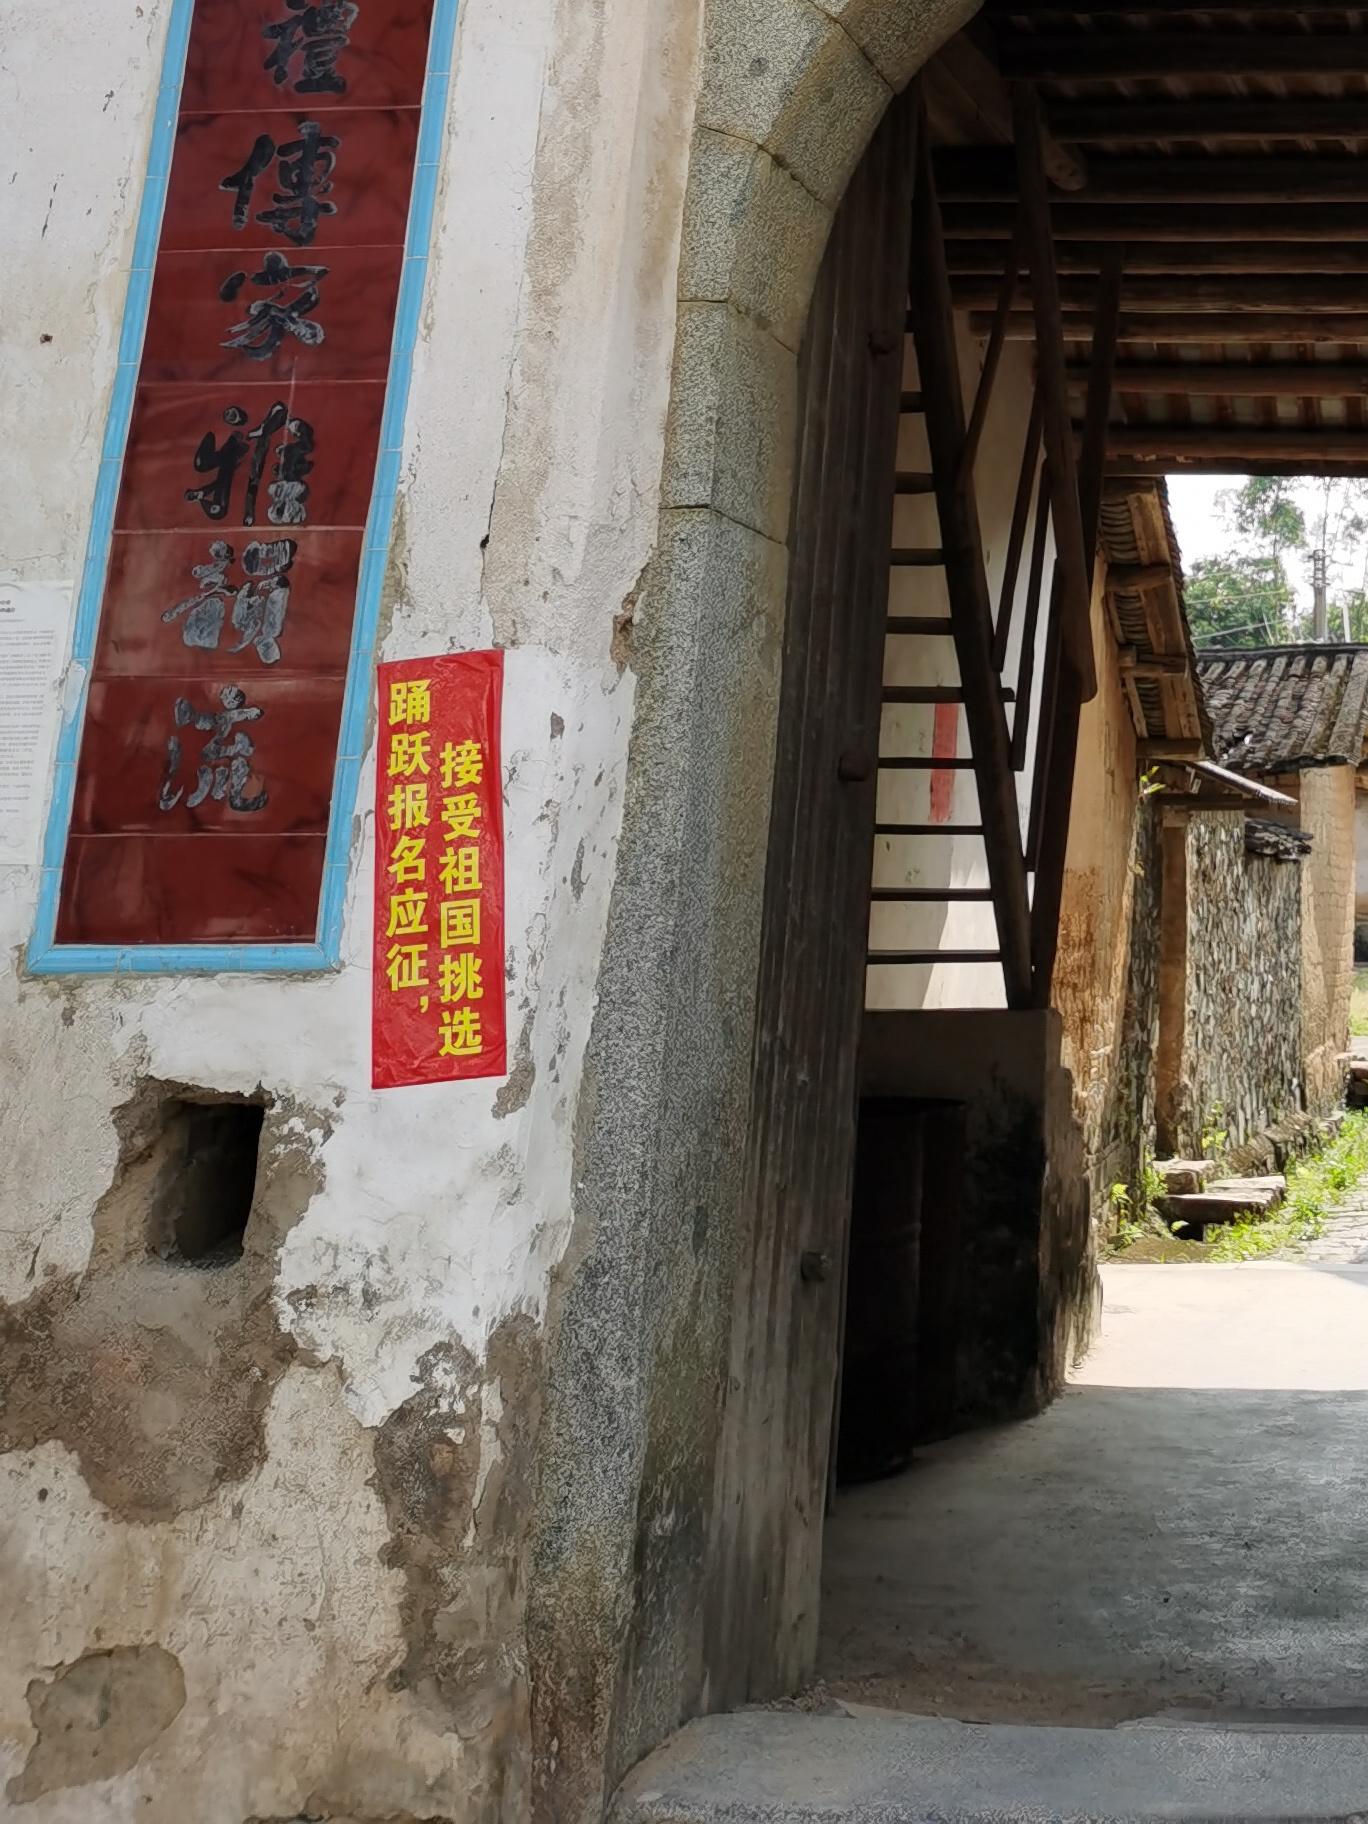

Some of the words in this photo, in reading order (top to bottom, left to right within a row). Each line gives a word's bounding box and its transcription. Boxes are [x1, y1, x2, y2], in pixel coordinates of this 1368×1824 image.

[437, 739, 484, 1058] 接受祖国挑选
